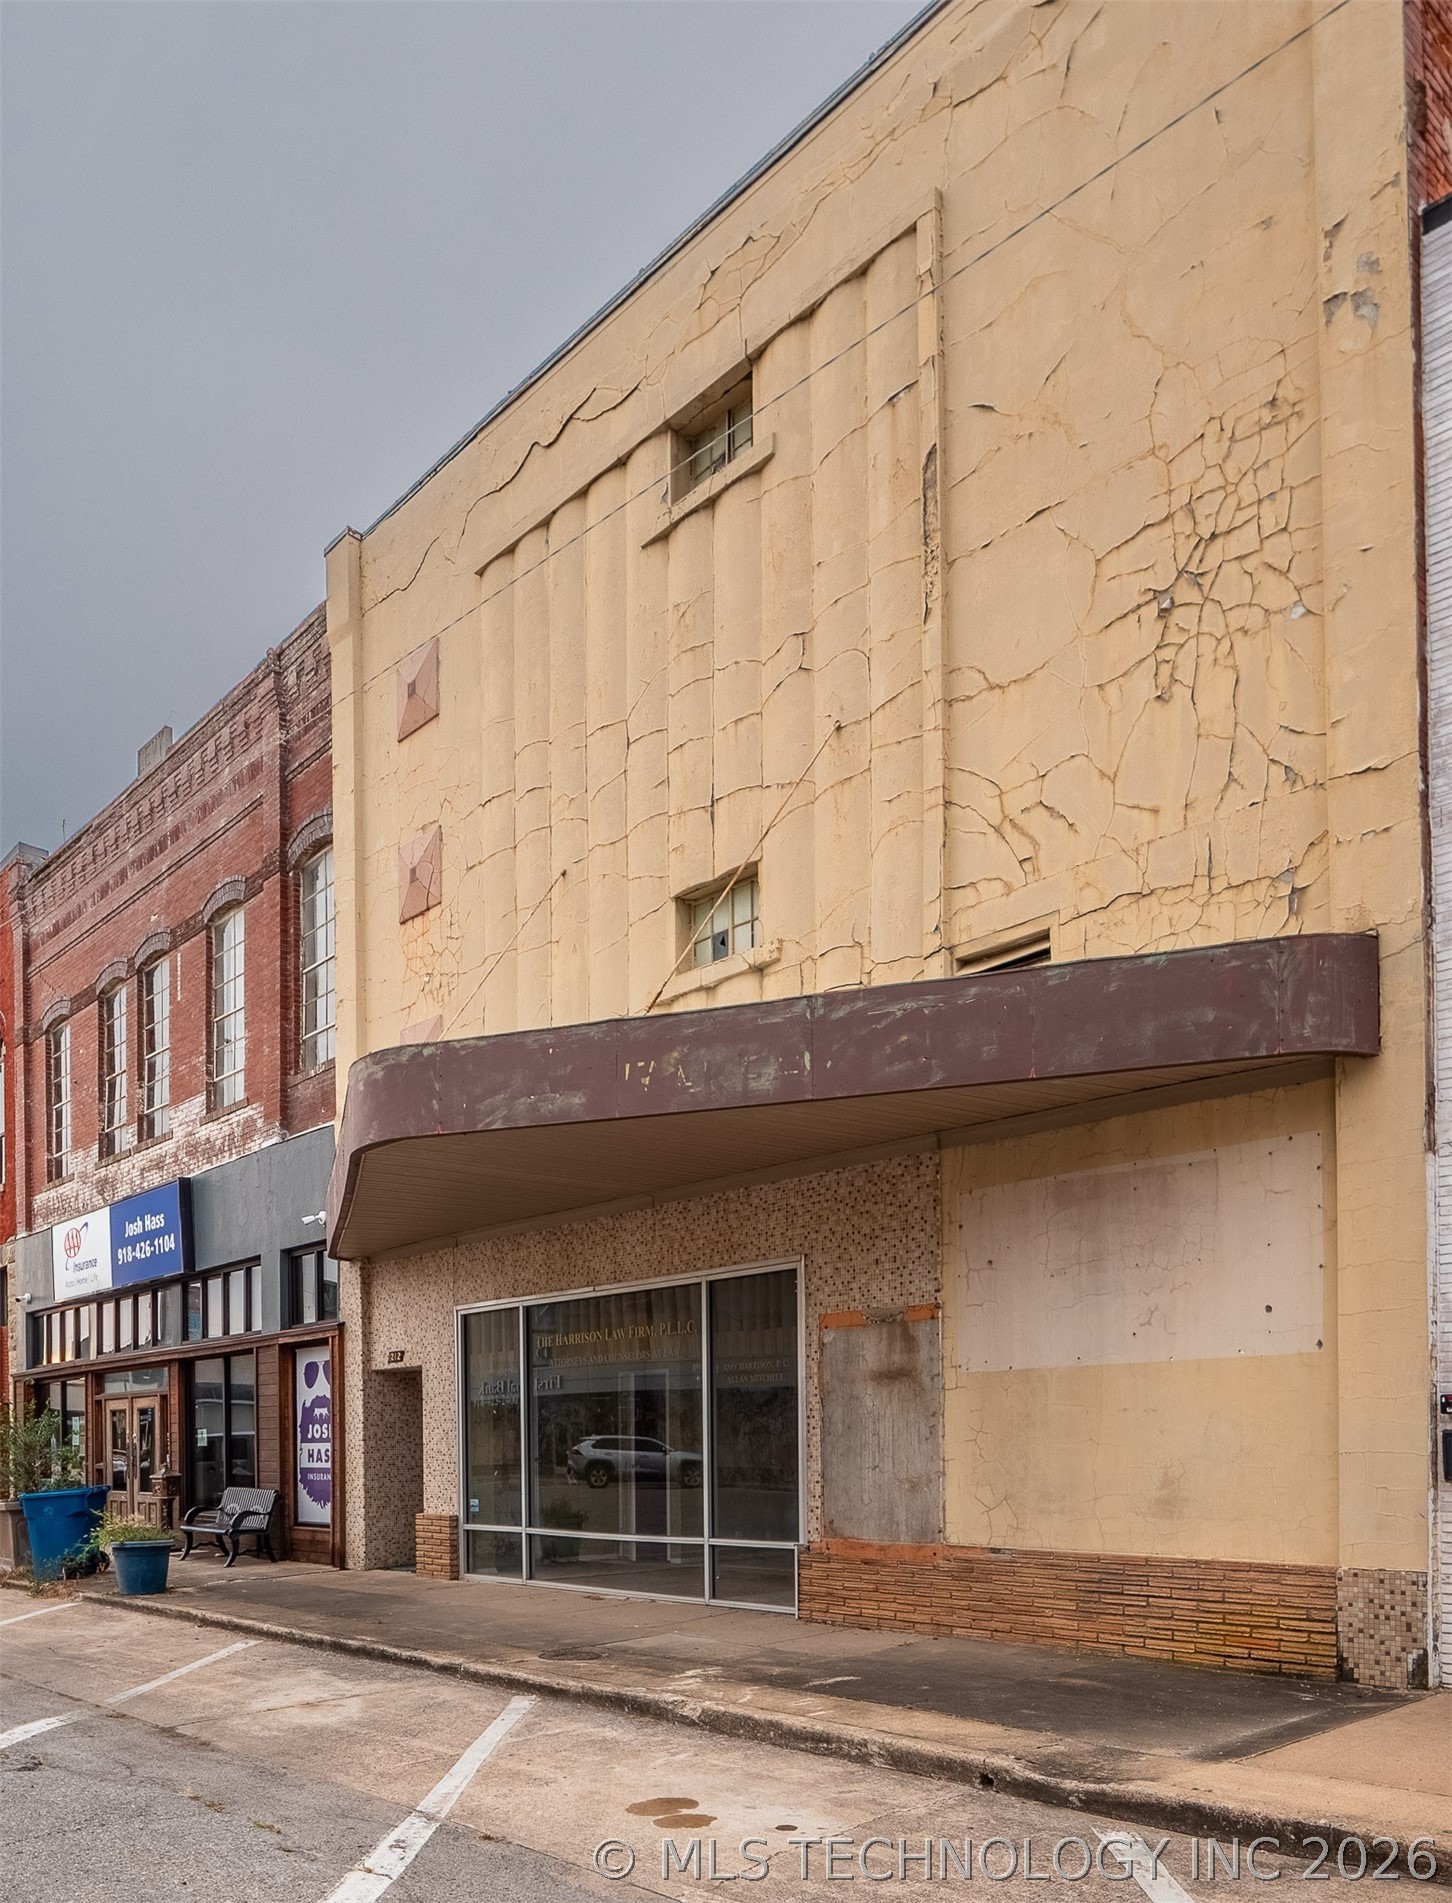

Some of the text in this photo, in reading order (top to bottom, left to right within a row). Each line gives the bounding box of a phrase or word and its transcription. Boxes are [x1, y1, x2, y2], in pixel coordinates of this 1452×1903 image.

[125, 1213, 165, 1238] Josh Hass
[117, 1233, 175, 1265] 918-426-1104
[73, 1258, 97, 1273] Insurance
[536, 1335, 552, 1348] THE
[556, 1330, 602, 1346] HARRISON
[605, 1327, 625, 1341] LAW
[660, 1319, 697, 1336] P.L.L.C.
